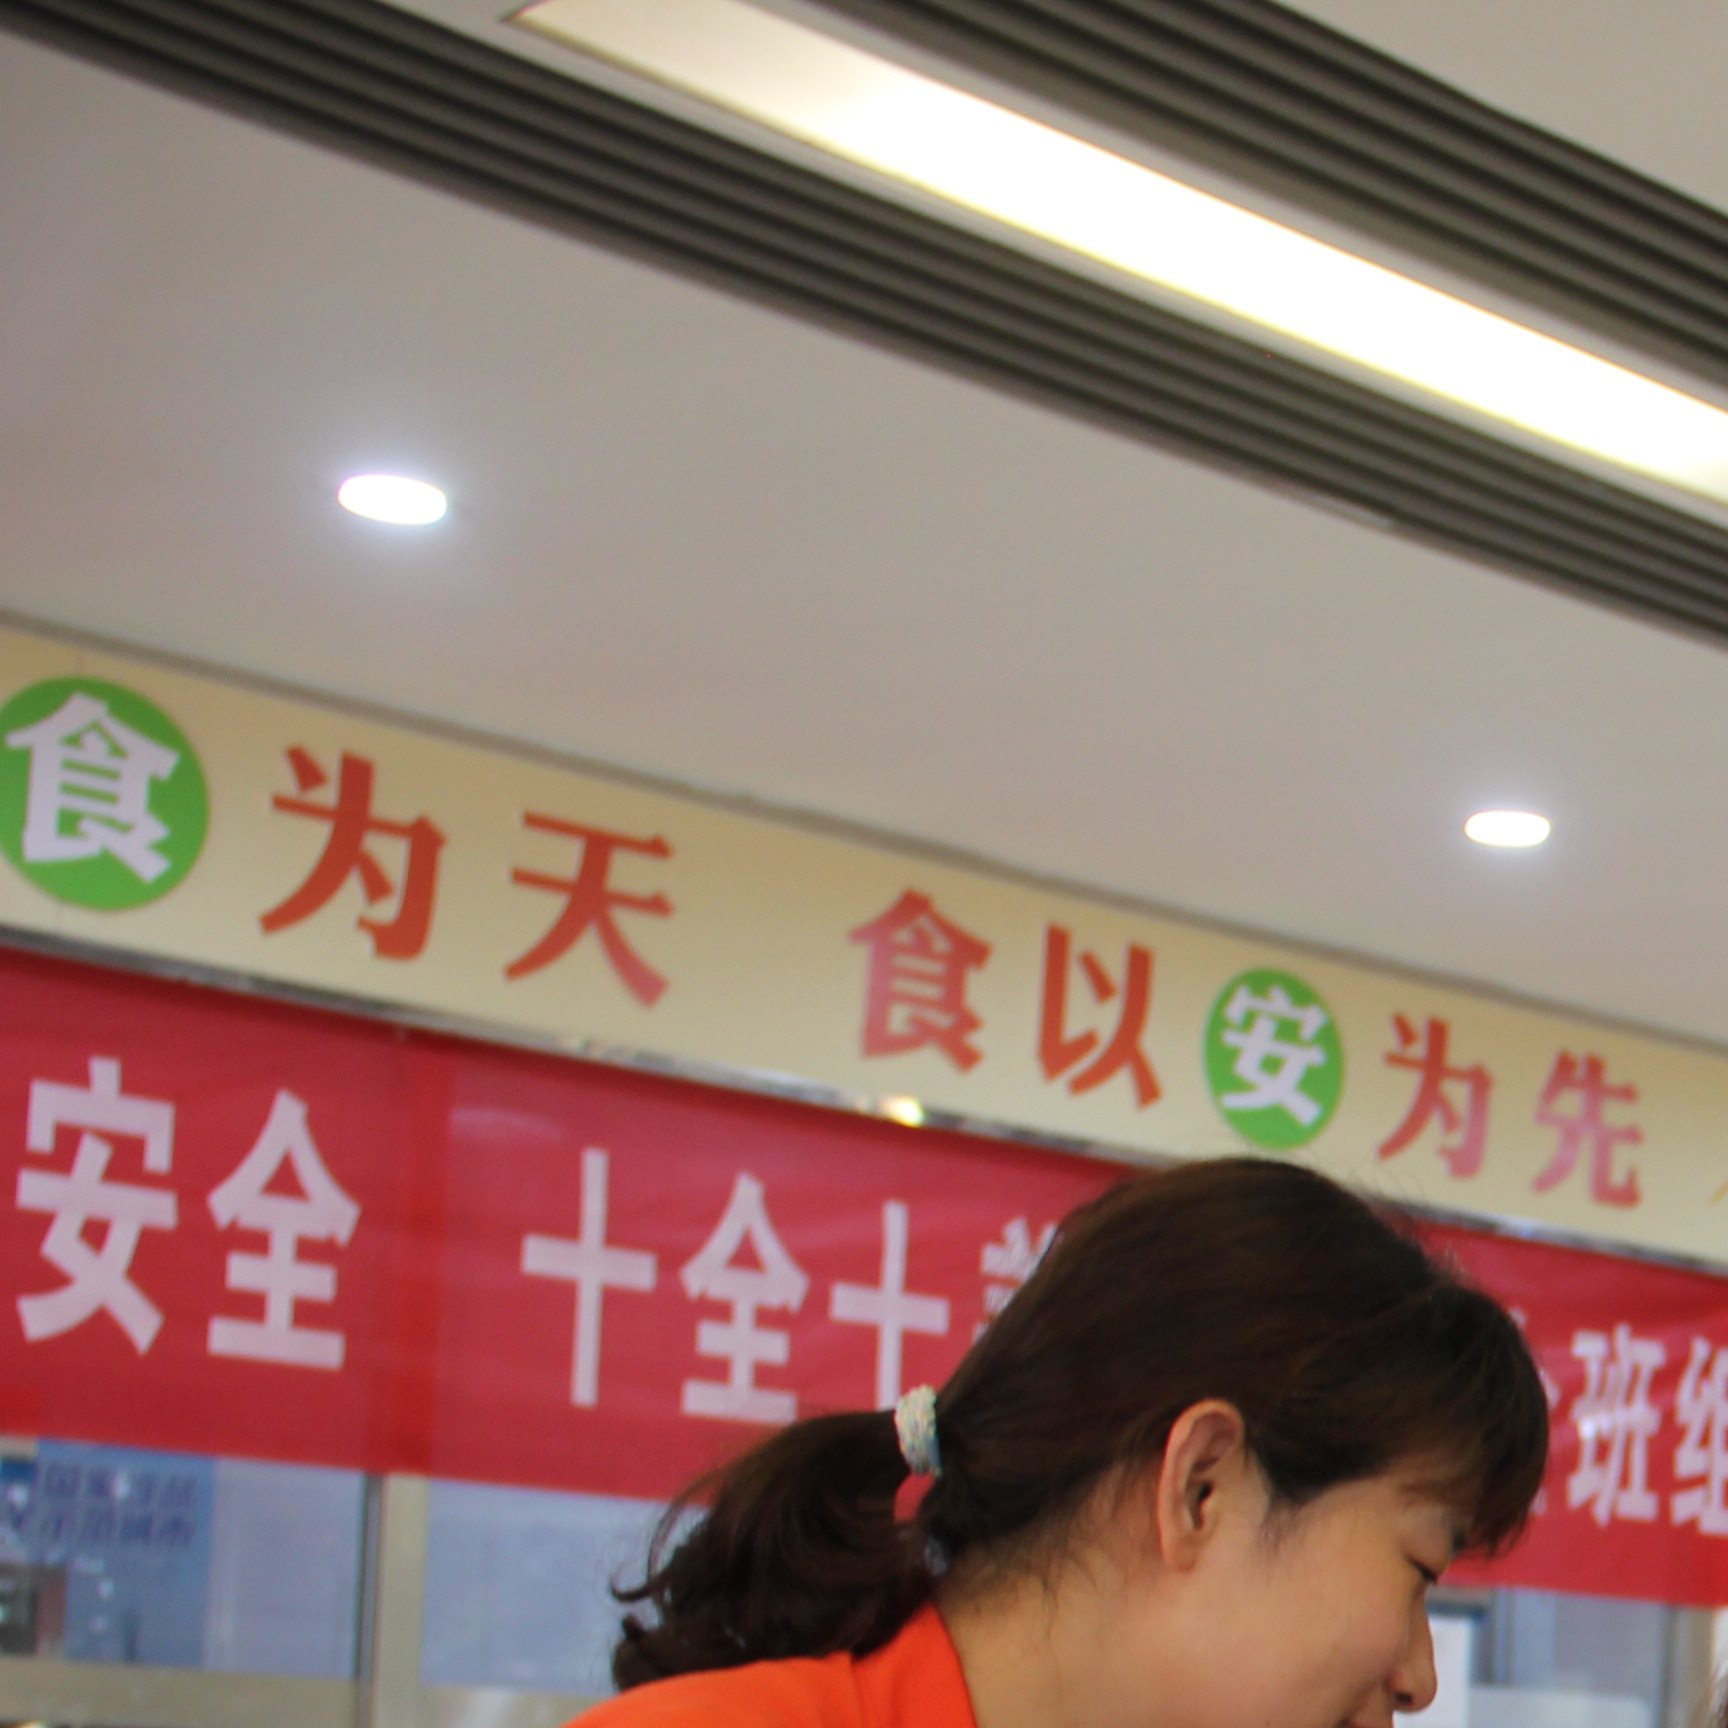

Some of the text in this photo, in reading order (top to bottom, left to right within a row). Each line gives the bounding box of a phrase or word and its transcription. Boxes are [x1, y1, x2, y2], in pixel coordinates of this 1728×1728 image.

[5, 691, 1646, 1210] 食为天 食以安为先
[16, 1056, 361, 1371] 安全
